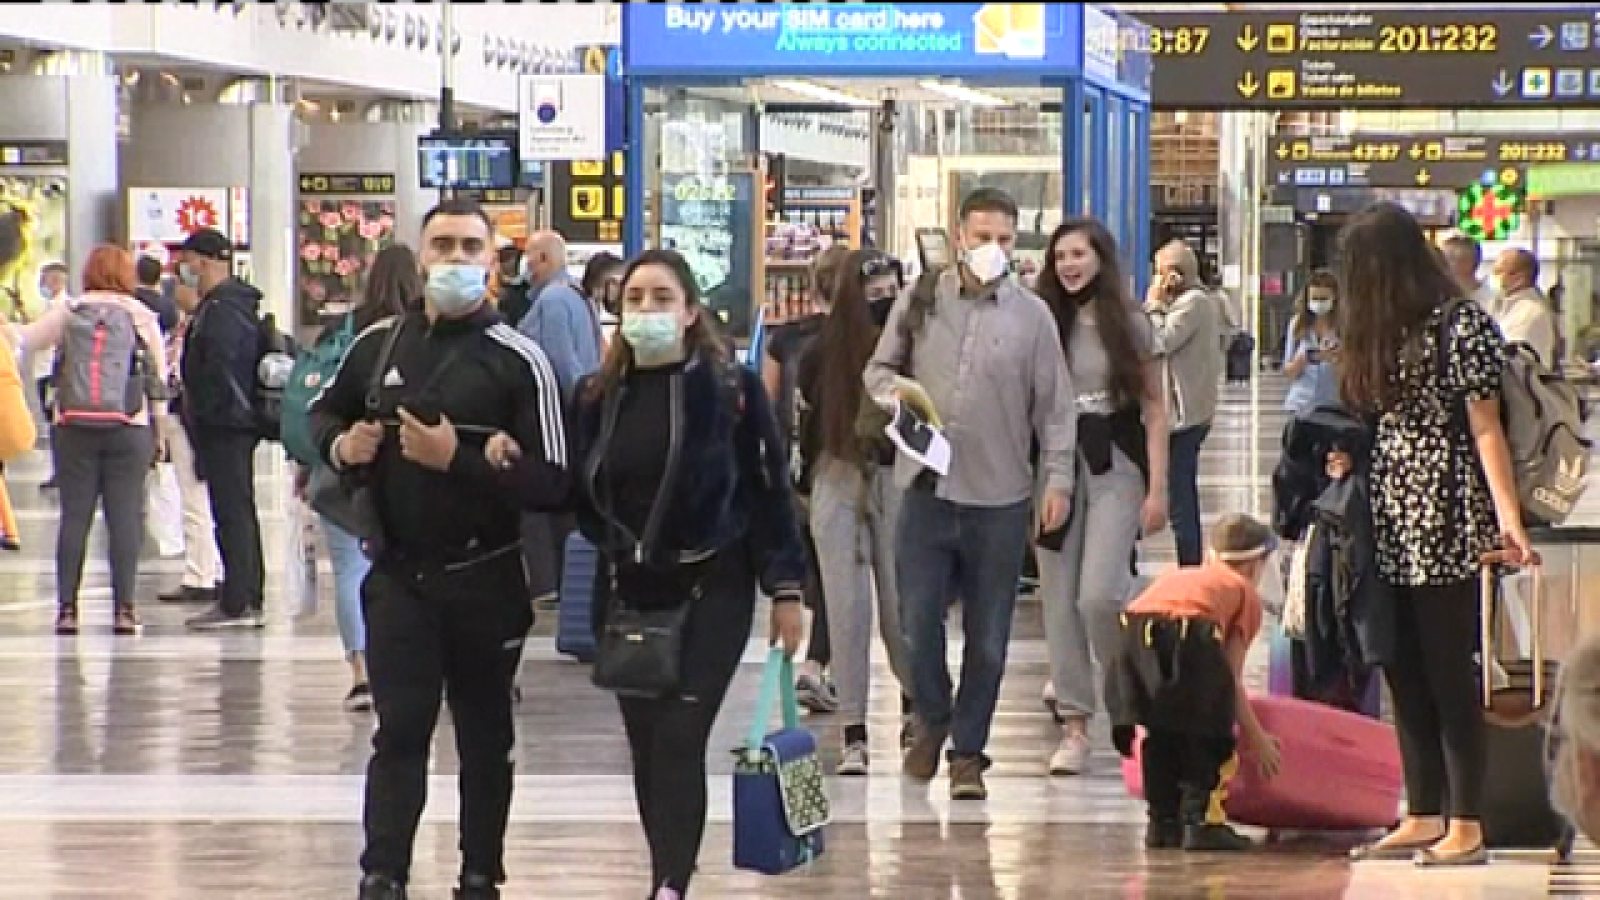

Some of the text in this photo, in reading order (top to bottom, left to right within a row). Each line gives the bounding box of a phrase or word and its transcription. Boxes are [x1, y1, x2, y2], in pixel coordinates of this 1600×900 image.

[666, 6, 945, 34] Buy your SIM card here
[776, 32, 961, 53] Always connected
[1147, 27, 1211, 53] 3:87
[1379, 25, 1497, 51] 201:232
